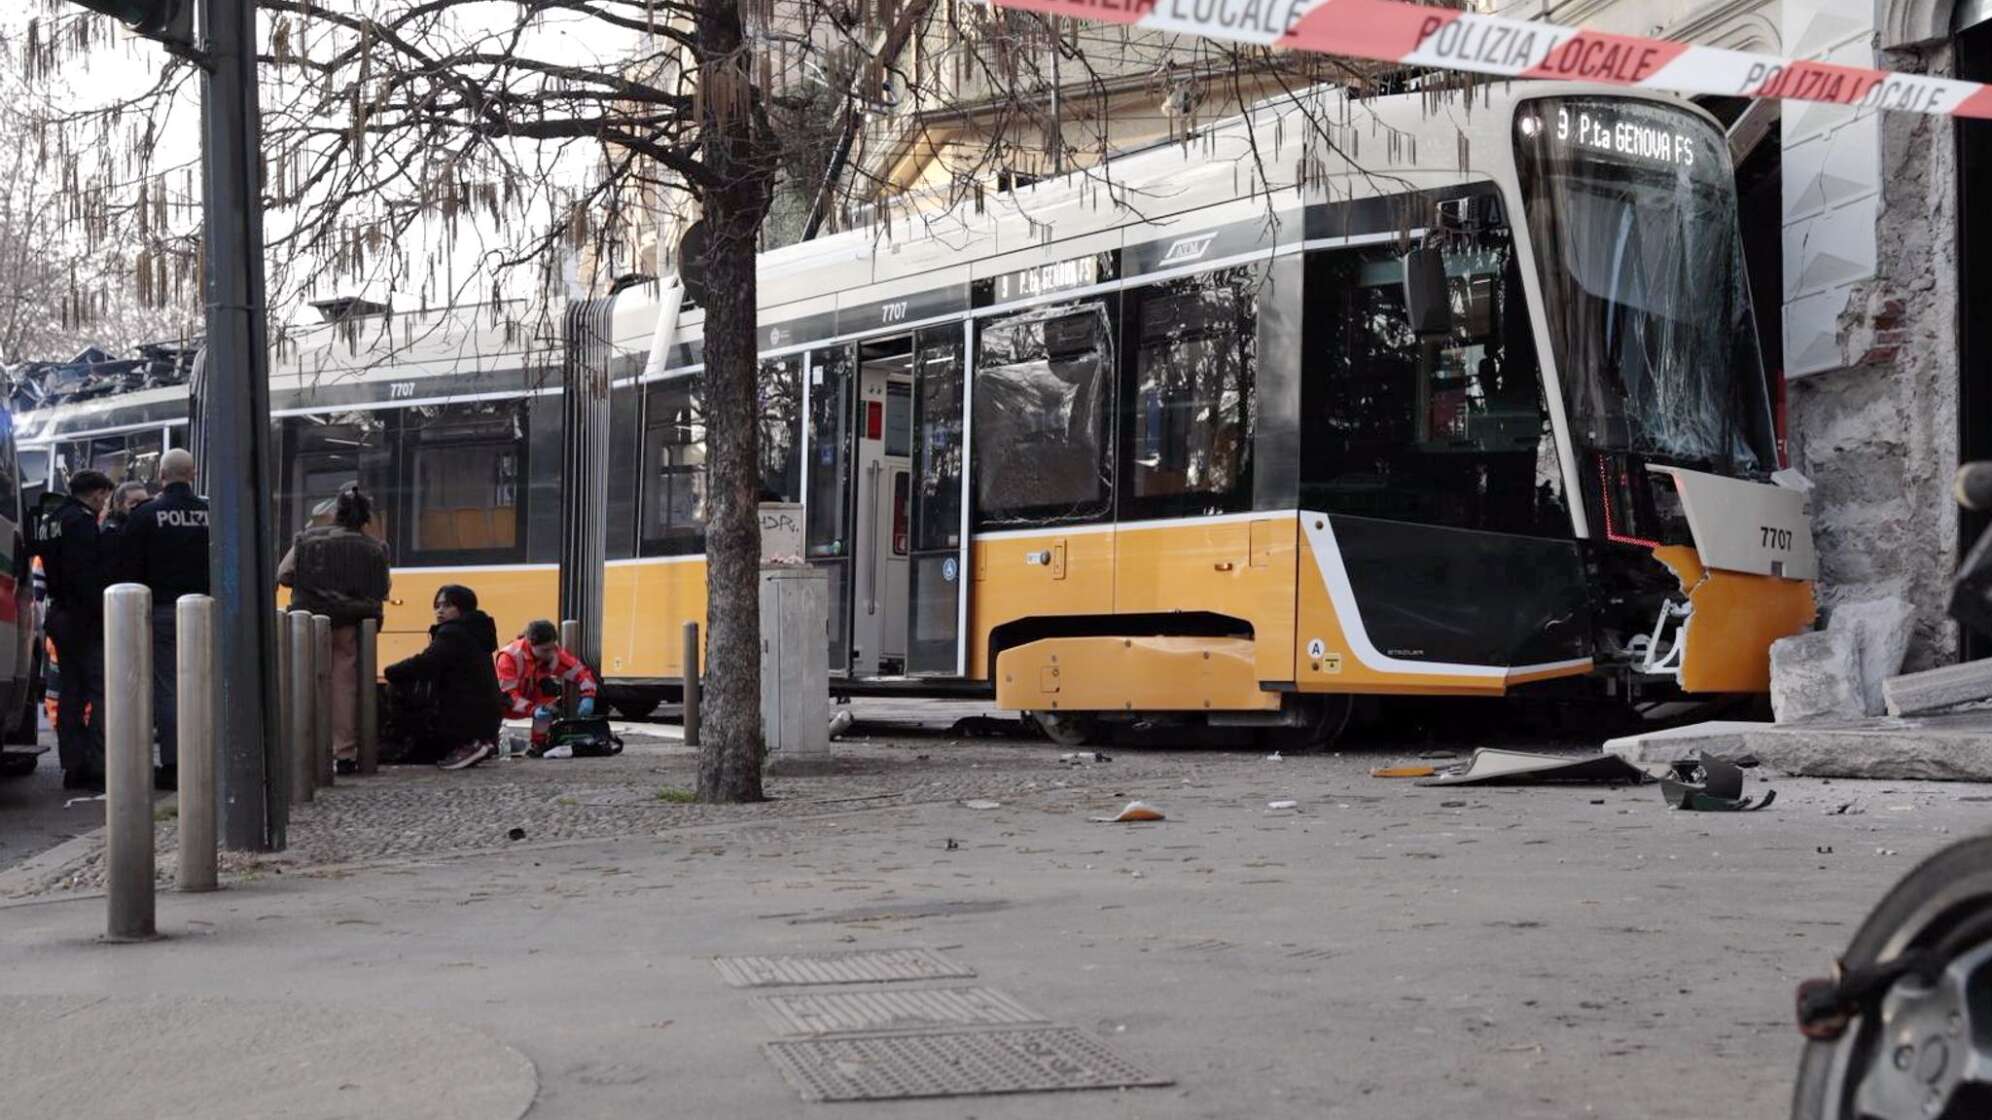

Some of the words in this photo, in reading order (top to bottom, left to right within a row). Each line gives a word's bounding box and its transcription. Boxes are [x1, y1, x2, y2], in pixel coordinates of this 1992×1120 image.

[1170, 0, 1303, 36] LOCALE
[1414, 15, 1537, 67] POLIZIA
[1538, 35, 1659, 82] LOCALE
[1739, 62, 1846, 102] POLIZIA
[1847, 72, 1945, 111] LOCALE
[1557, 106, 1569, 140] 9
[1580, 114, 1611, 149] P.ta
[1615, 122, 1671, 162] GENOVA
[1675, 135, 1694, 166] FS
[881, 301, 908, 323] 7707
[389, 382, 416, 398] 7707
[1760, 526, 1792, 552] 7707
